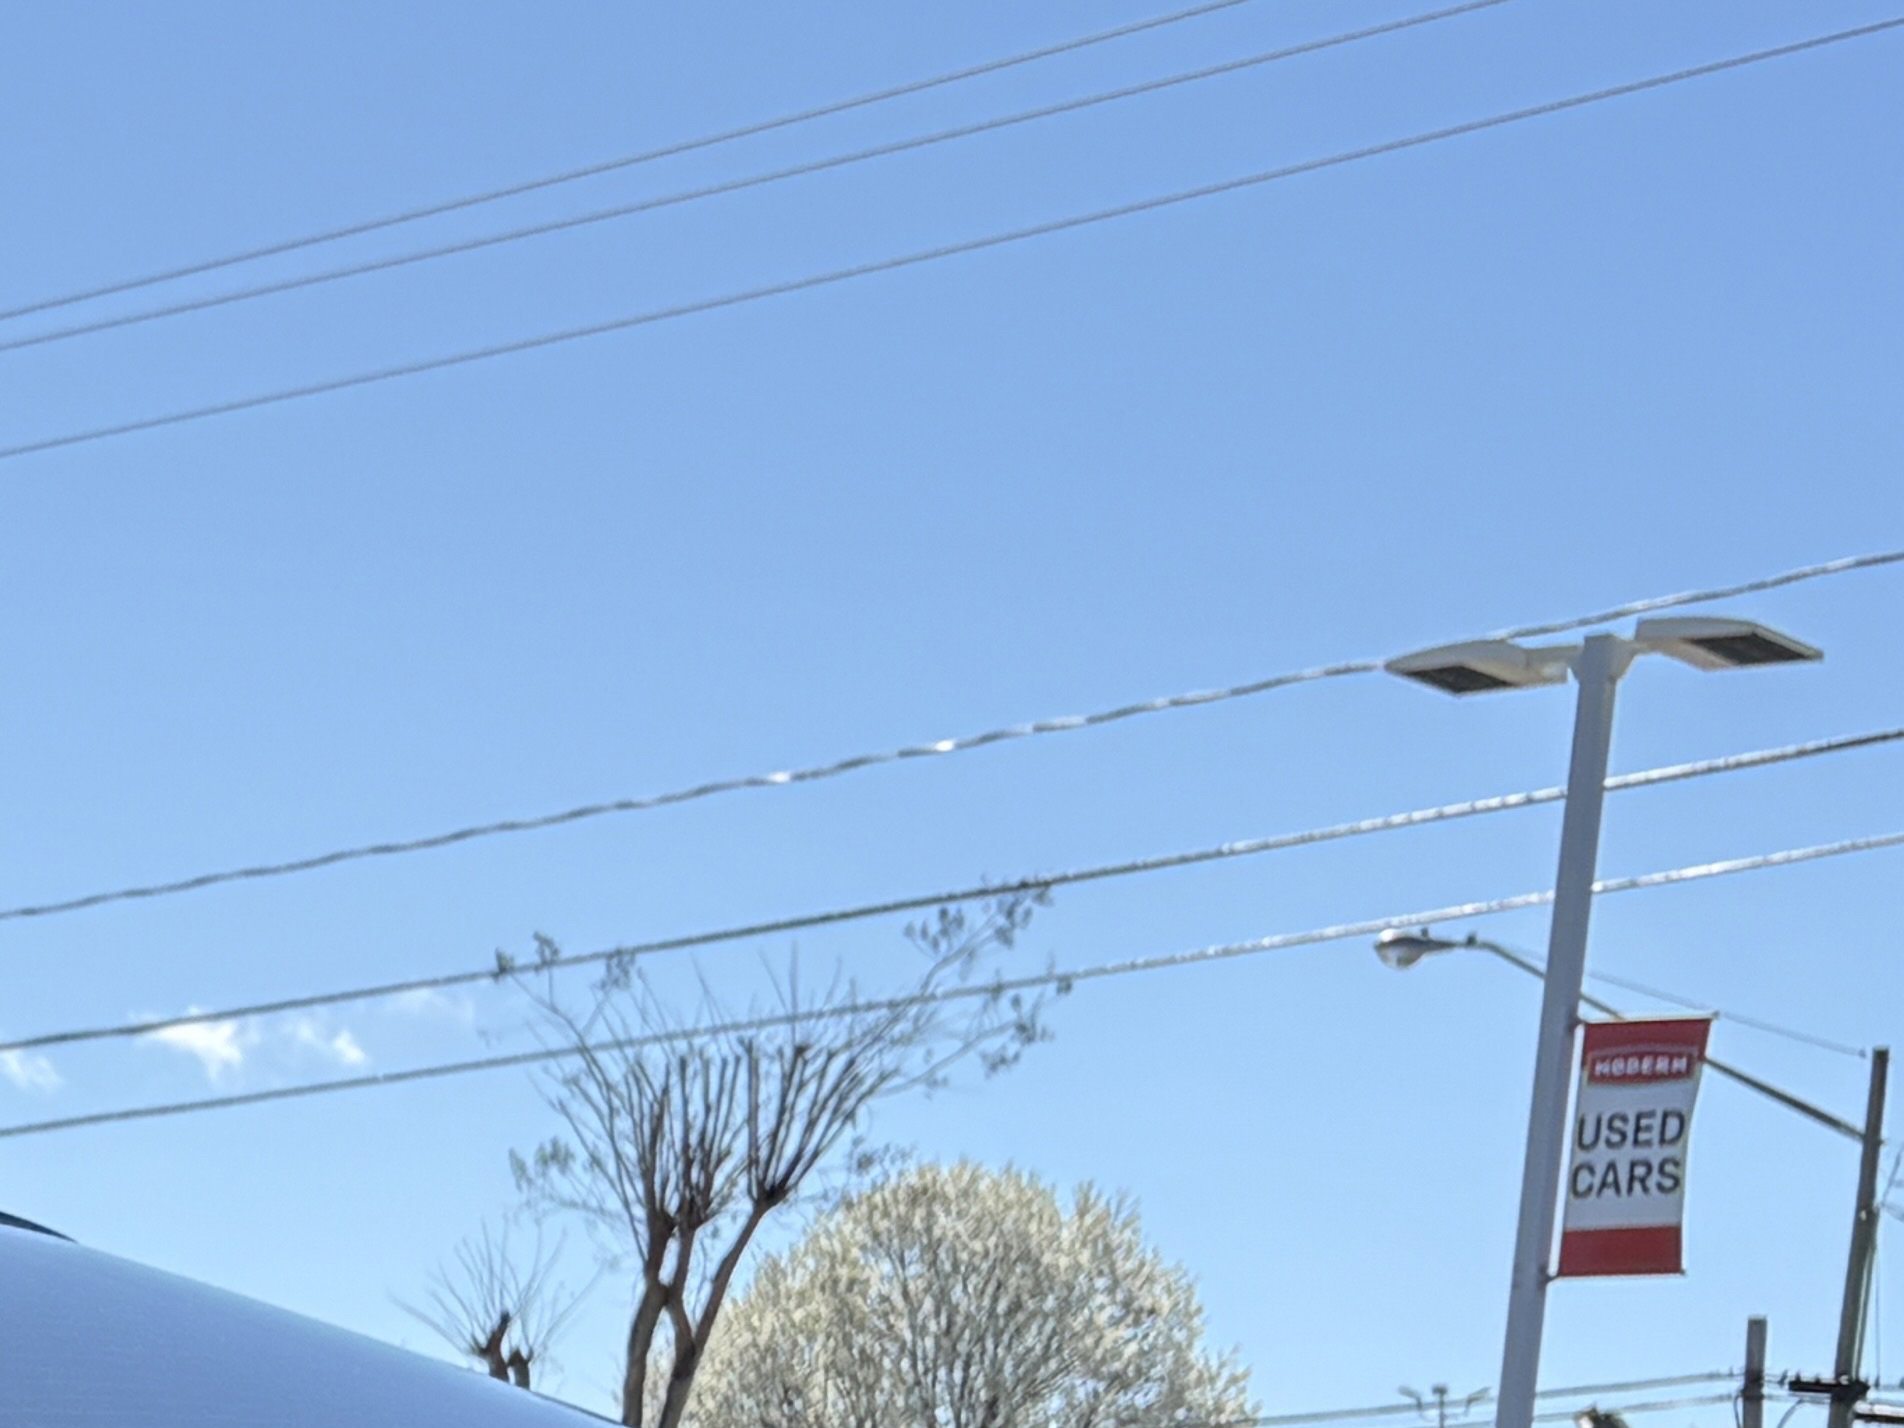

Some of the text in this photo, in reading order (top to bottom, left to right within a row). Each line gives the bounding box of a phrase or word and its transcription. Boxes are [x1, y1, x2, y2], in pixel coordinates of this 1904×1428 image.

[1594, 1054, 1688, 1078] MODERN
[1577, 1109, 1686, 1152] USED
[1571, 1157, 1681, 1198] CARS
